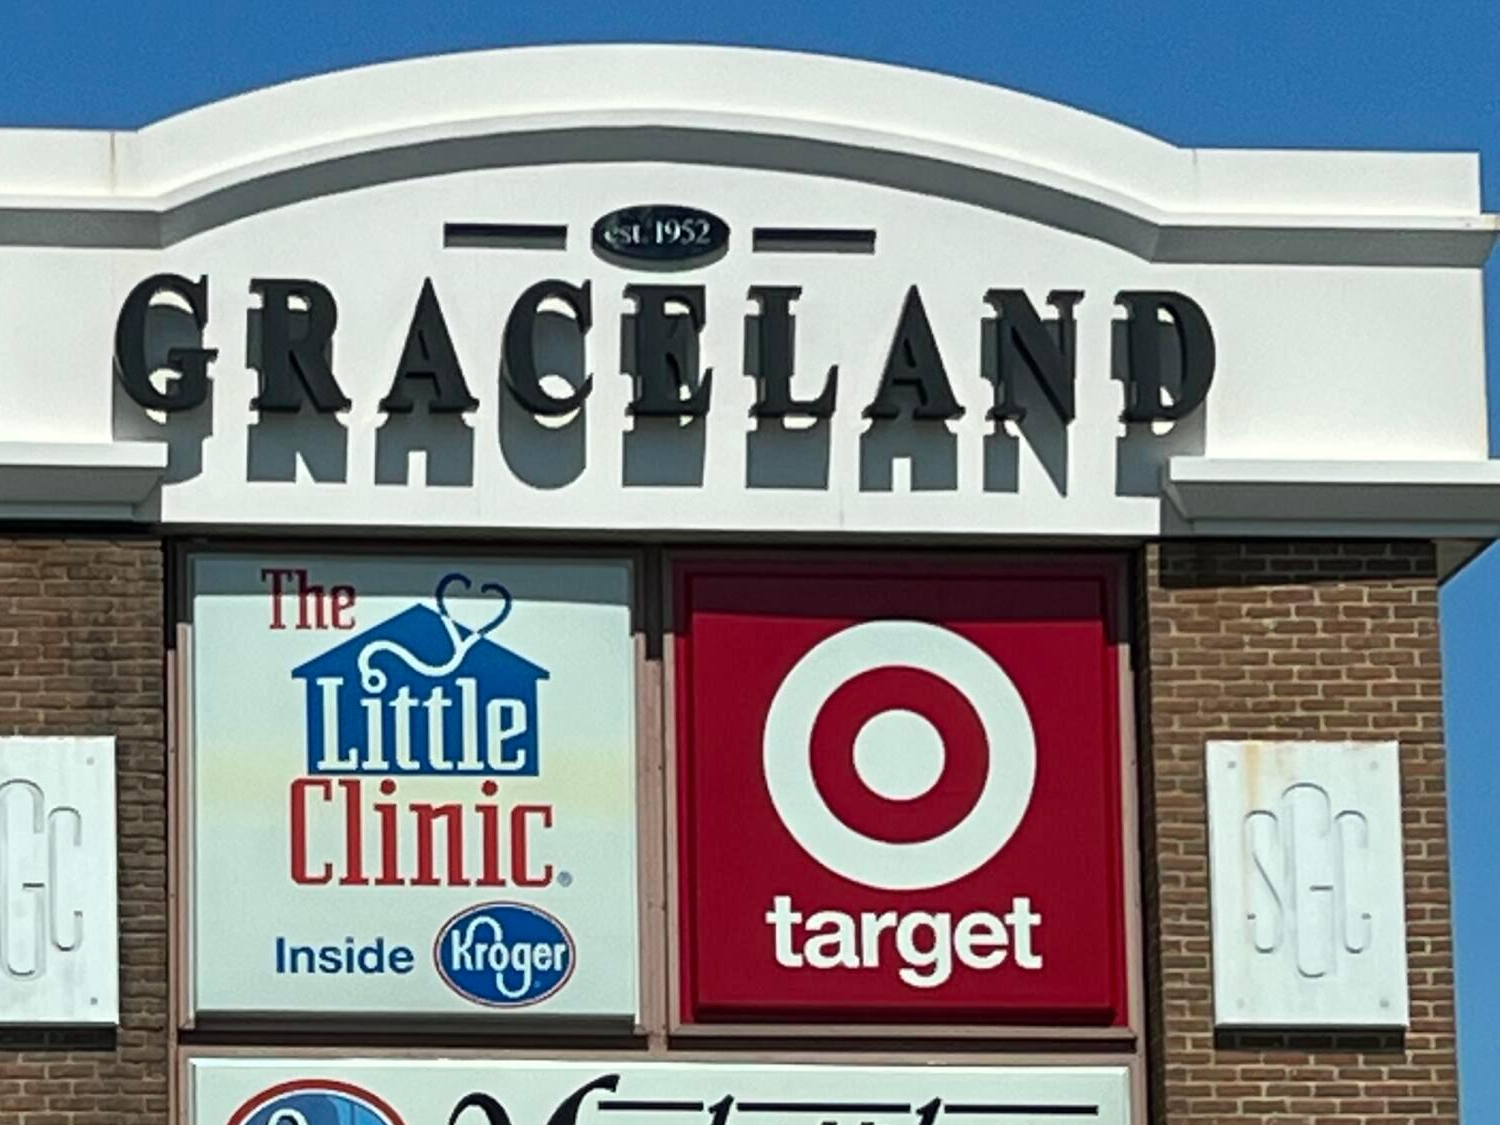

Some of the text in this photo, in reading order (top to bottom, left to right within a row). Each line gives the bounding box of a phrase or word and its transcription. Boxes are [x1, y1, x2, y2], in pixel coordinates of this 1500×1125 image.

[656, 219, 711, 245] 1952
[113, 273, 1217, 425] GRACELAND
[261, 568, 357, 630] The
[316, 676, 528, 771] Little
[289, 777, 554, 887] Clinic
[275, 915, 567, 998] Inside Kroger
[764, 894, 1044, 989] target
